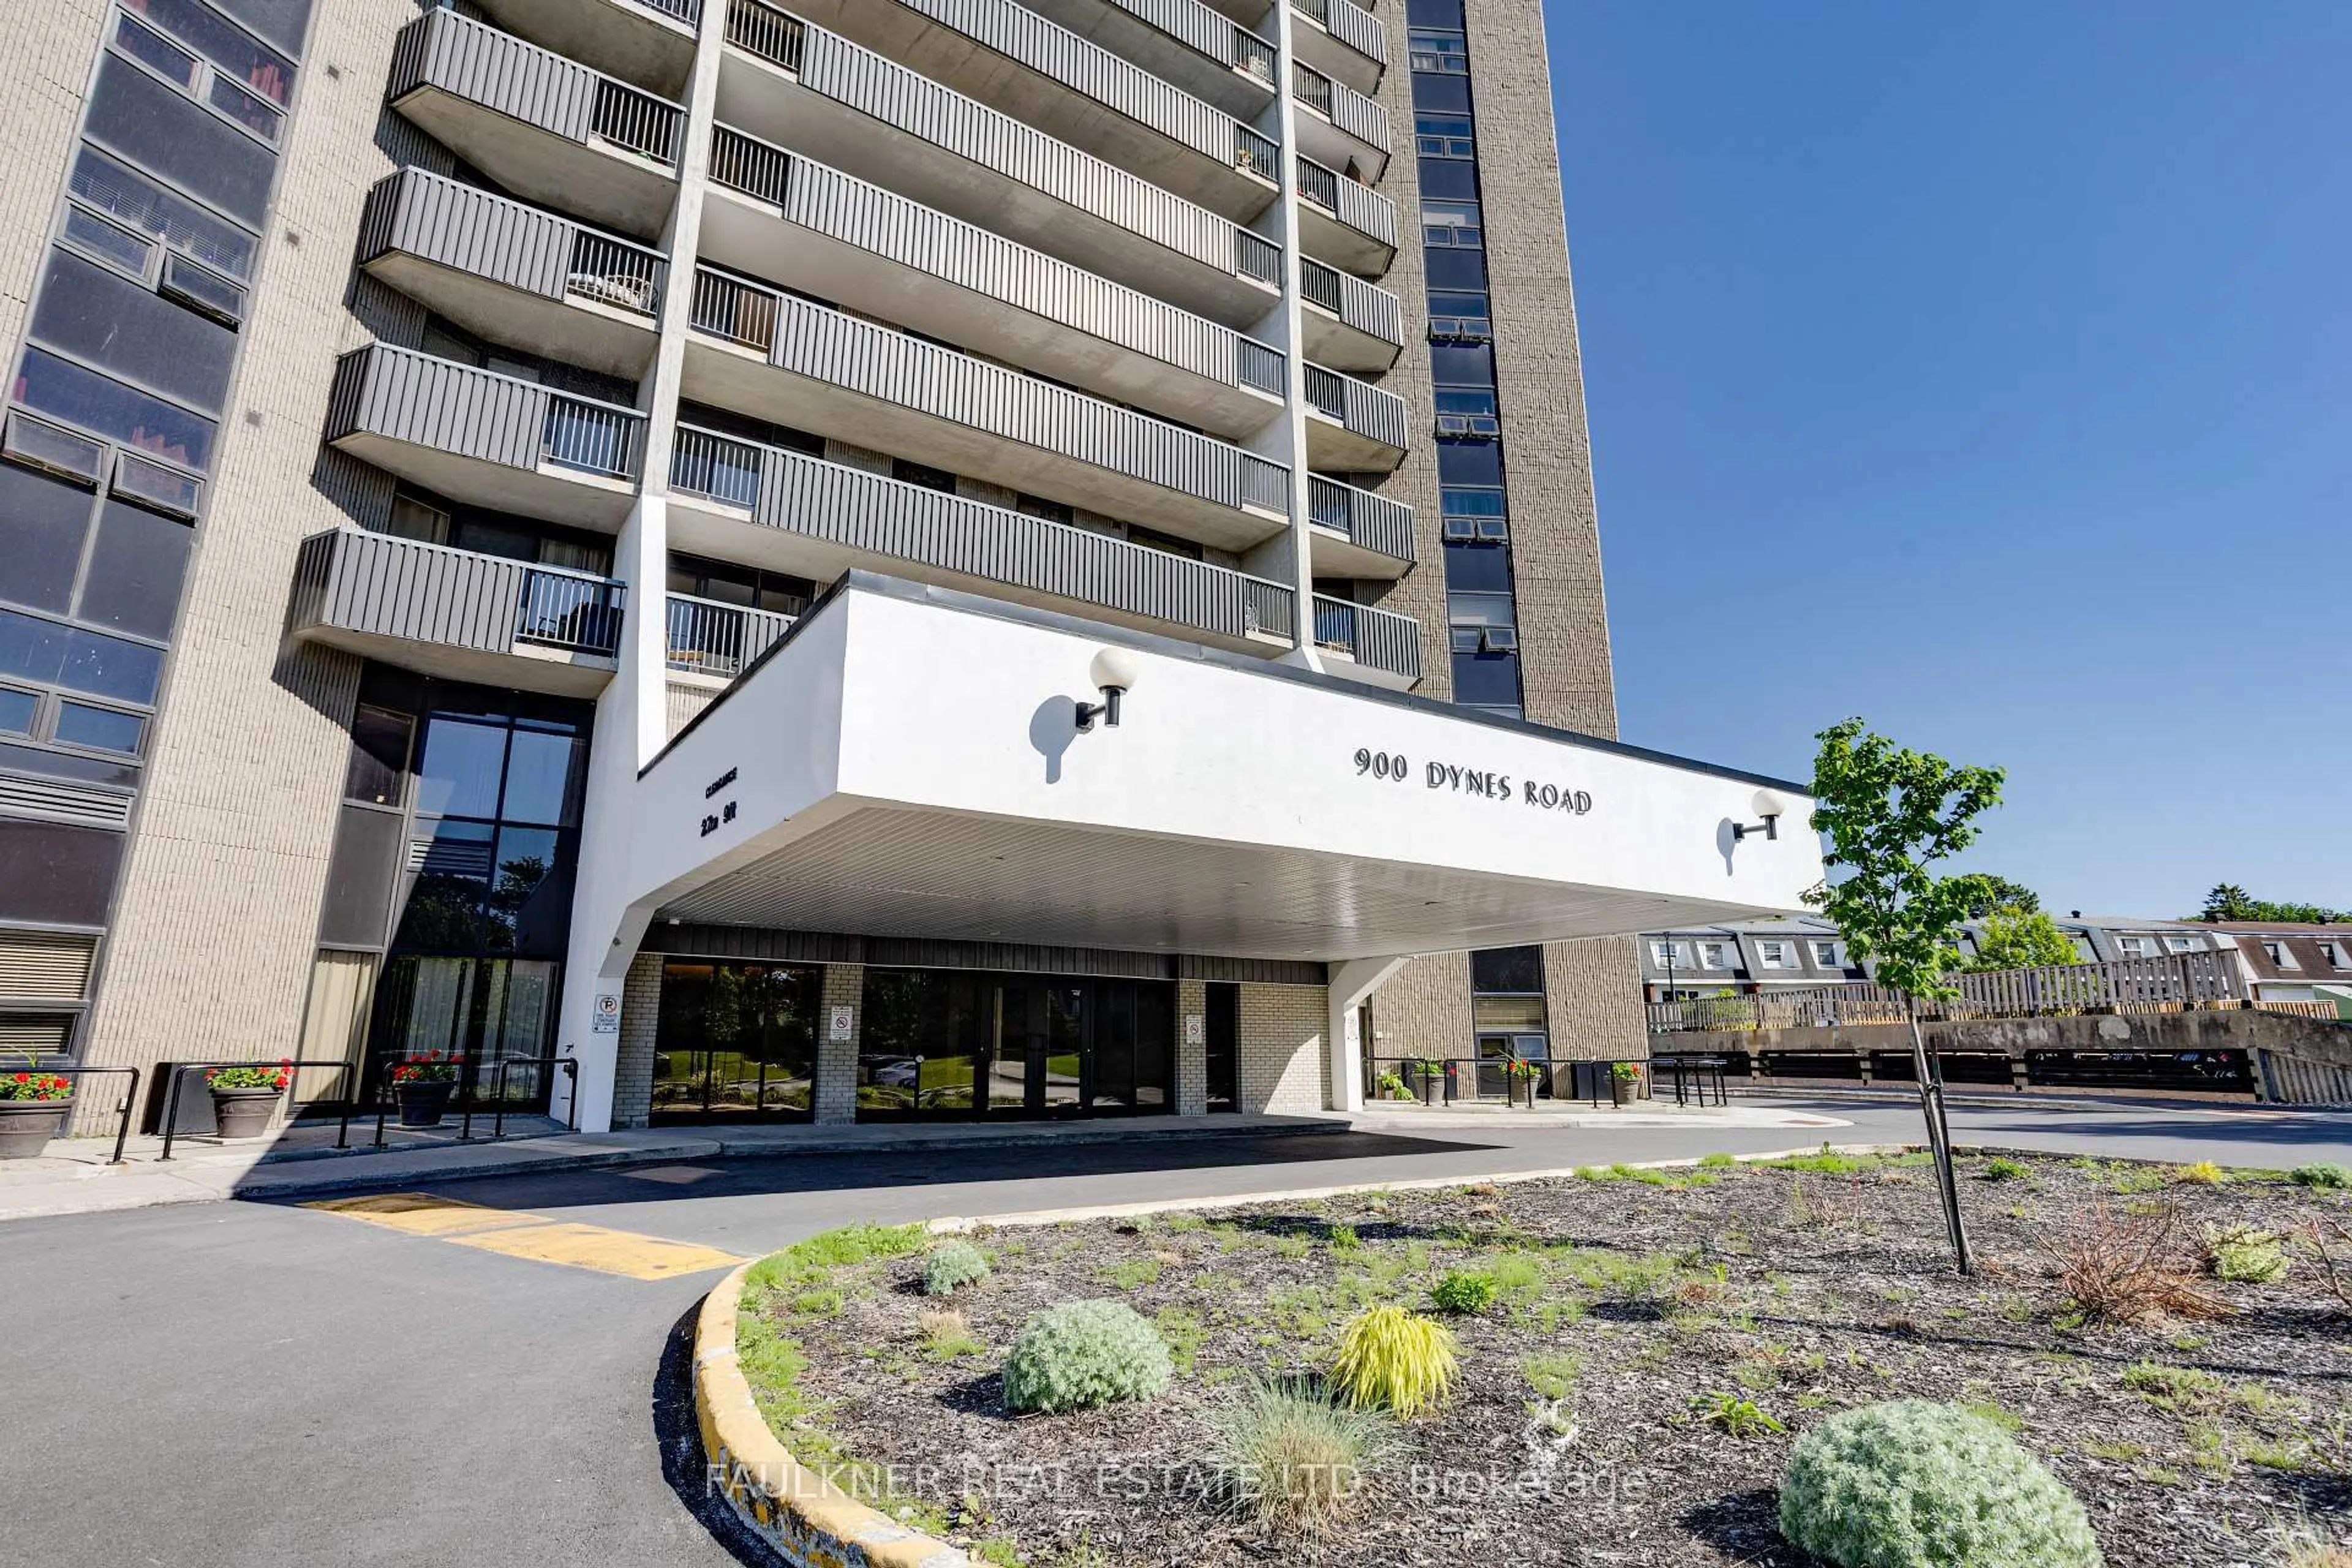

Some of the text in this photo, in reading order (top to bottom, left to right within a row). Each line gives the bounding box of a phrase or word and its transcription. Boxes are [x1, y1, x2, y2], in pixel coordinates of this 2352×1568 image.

[1354, 748, 1592, 815] 900 DYNES ROAD
